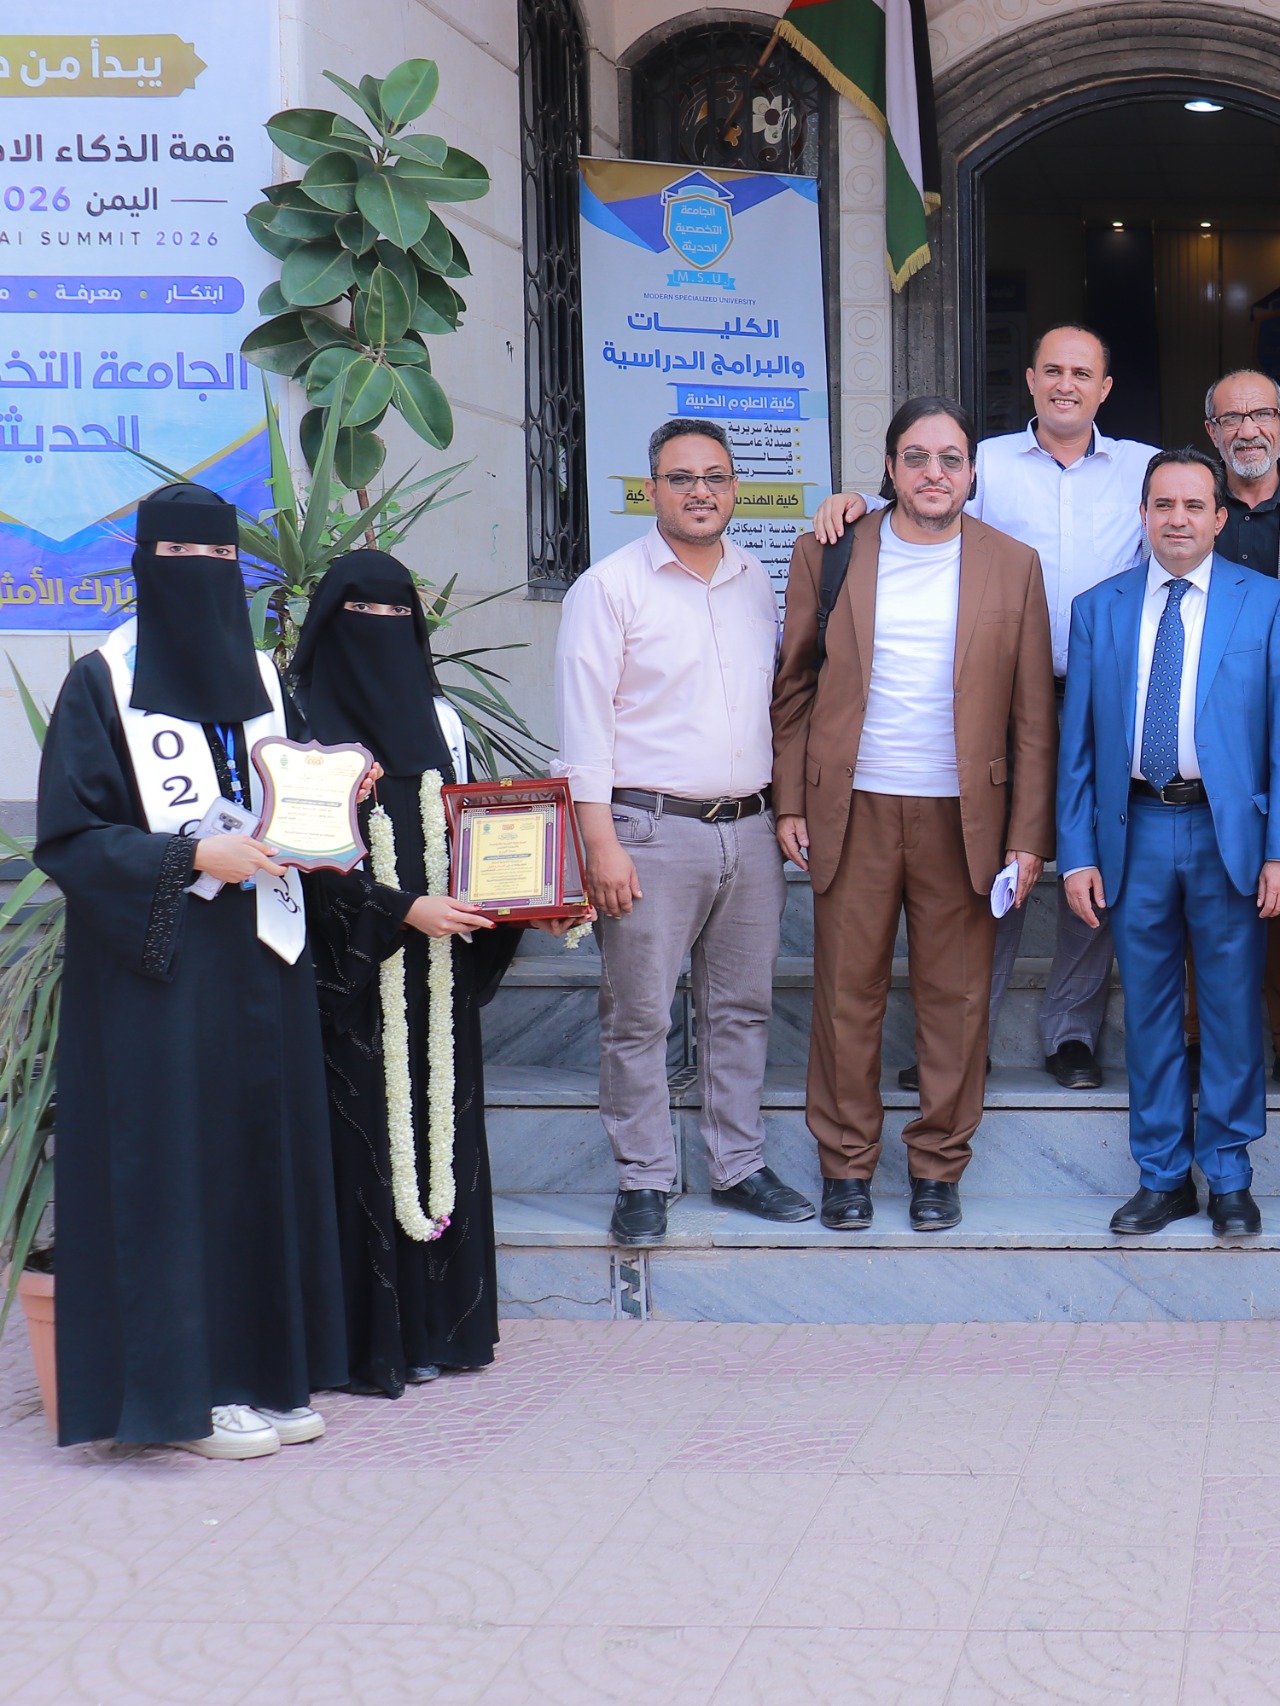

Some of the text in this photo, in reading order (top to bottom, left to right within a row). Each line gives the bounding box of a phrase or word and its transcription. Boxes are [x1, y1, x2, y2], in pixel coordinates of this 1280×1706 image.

[20, 50, 81, 87] من
[90, 38, 162, 87] يبدأ
[55, 133, 158, 162] الذكاء
[169, 133, 234, 162] قمة
[3, 186, 158, 217] اليمن 026
[680, 205, 715, 218] الجامعة
[41, 231, 141, 246] SUMMIT
[156, 231, 218, 246] 2026
[675, 222, 722, 236] التخصصية
[682, 241, 717, 254] الحديثة
[55, 284, 224, 304] ابتكار معرفة
[643, 292, 757, 306] MODERN SPECIALIZED UNIVERSITY
[602, 340, 805, 379] والبرامج الدراسية
[0, 350, 248, 402] الجامعة التخ
[685, 393, 796, 413] كلية العلوم الطبية
[0, 405, 140, 464] الحديث
[727, 421, 792, 436] صيدلة سريرية
[764, 436, 792, 450] صيدلة
[776, 493, 799, 509] كلية
[726, 522, 797, 536] هندسة الميكاترو
[0, 566, 138, 613] يارك الأمث
